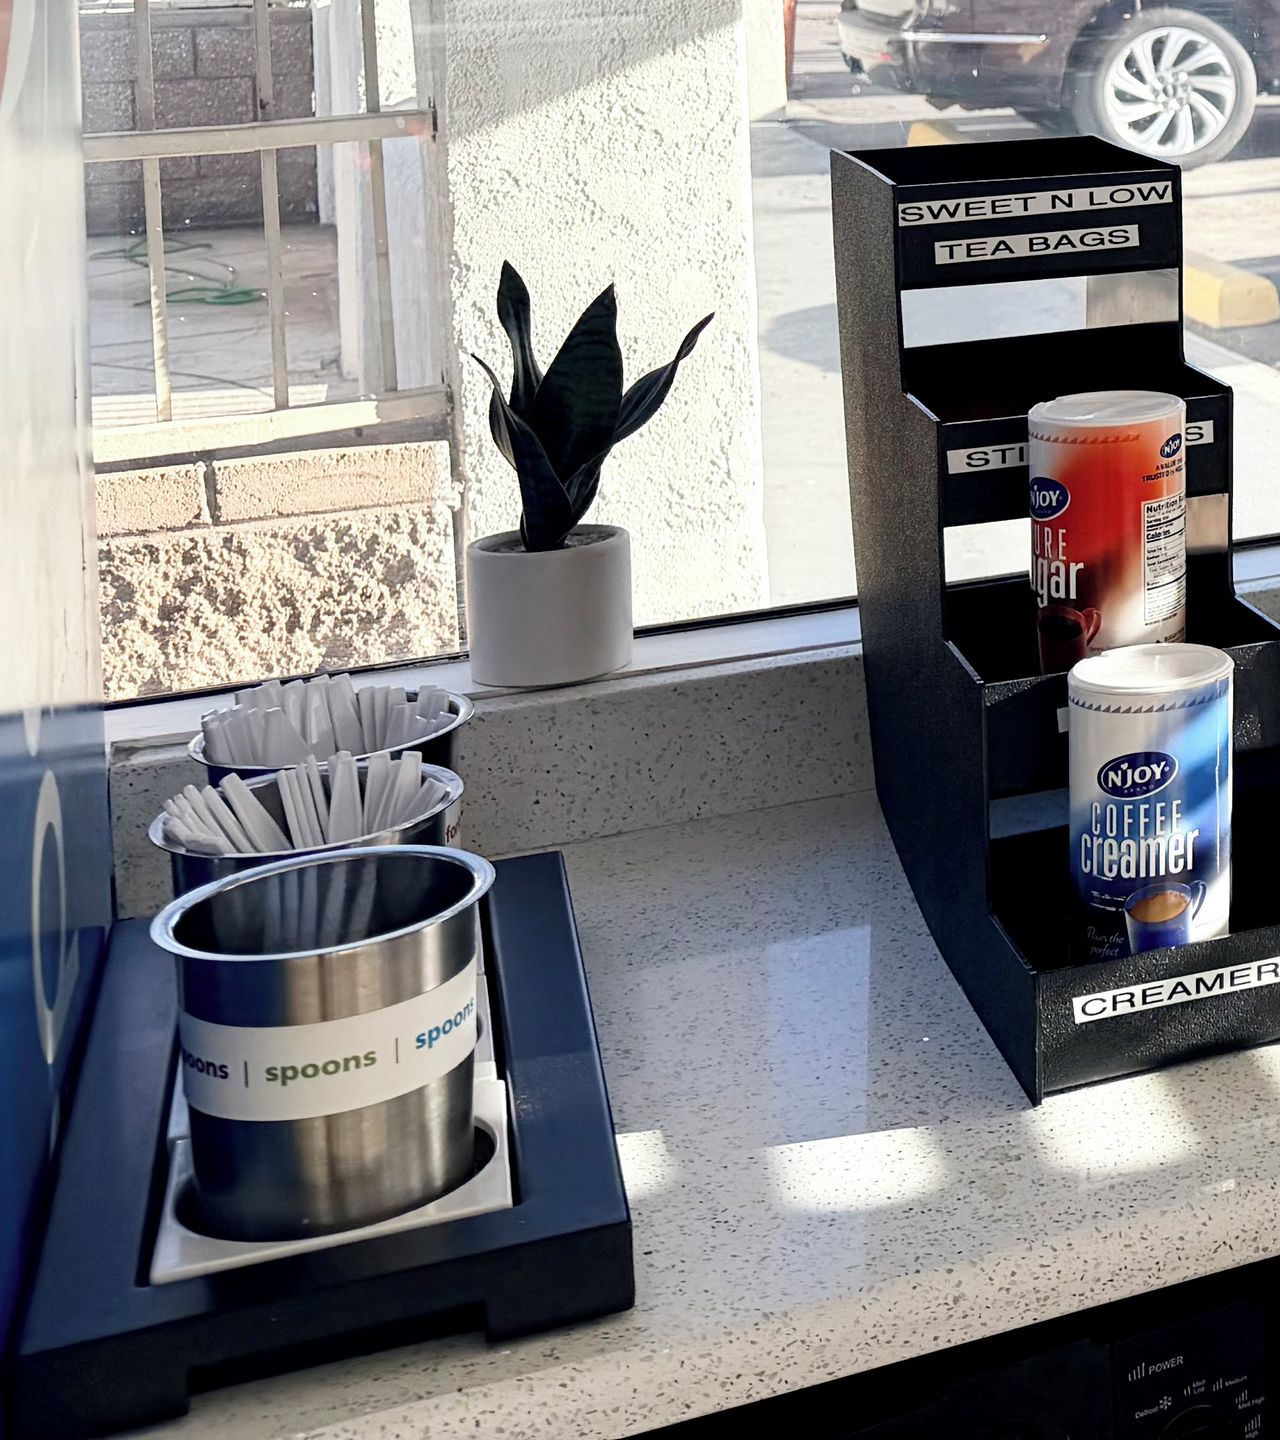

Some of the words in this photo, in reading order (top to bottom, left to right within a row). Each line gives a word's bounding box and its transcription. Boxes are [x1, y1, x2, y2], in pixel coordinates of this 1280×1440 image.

[900, 195, 1037, 223] SWEET
[1051, 193, 1074, 210] N
[1088, 184, 1171, 207] LOW
[940, 239, 1016, 261] TEA
[1029, 228, 1131, 253] BAGS
[1034, 524, 1067, 561] URE
[1146, 529, 1171, 540] Calories
[1030, 556, 1085, 609] ugar
[1091, 800, 1182, 838] COFFEE
[1080, 828, 1200, 880] creamer
[1081, 961, 1280, 1018] CREAMER
[265, 1049, 378, 1087] spoons
[1149, 1356, 1184, 1375] POWER
